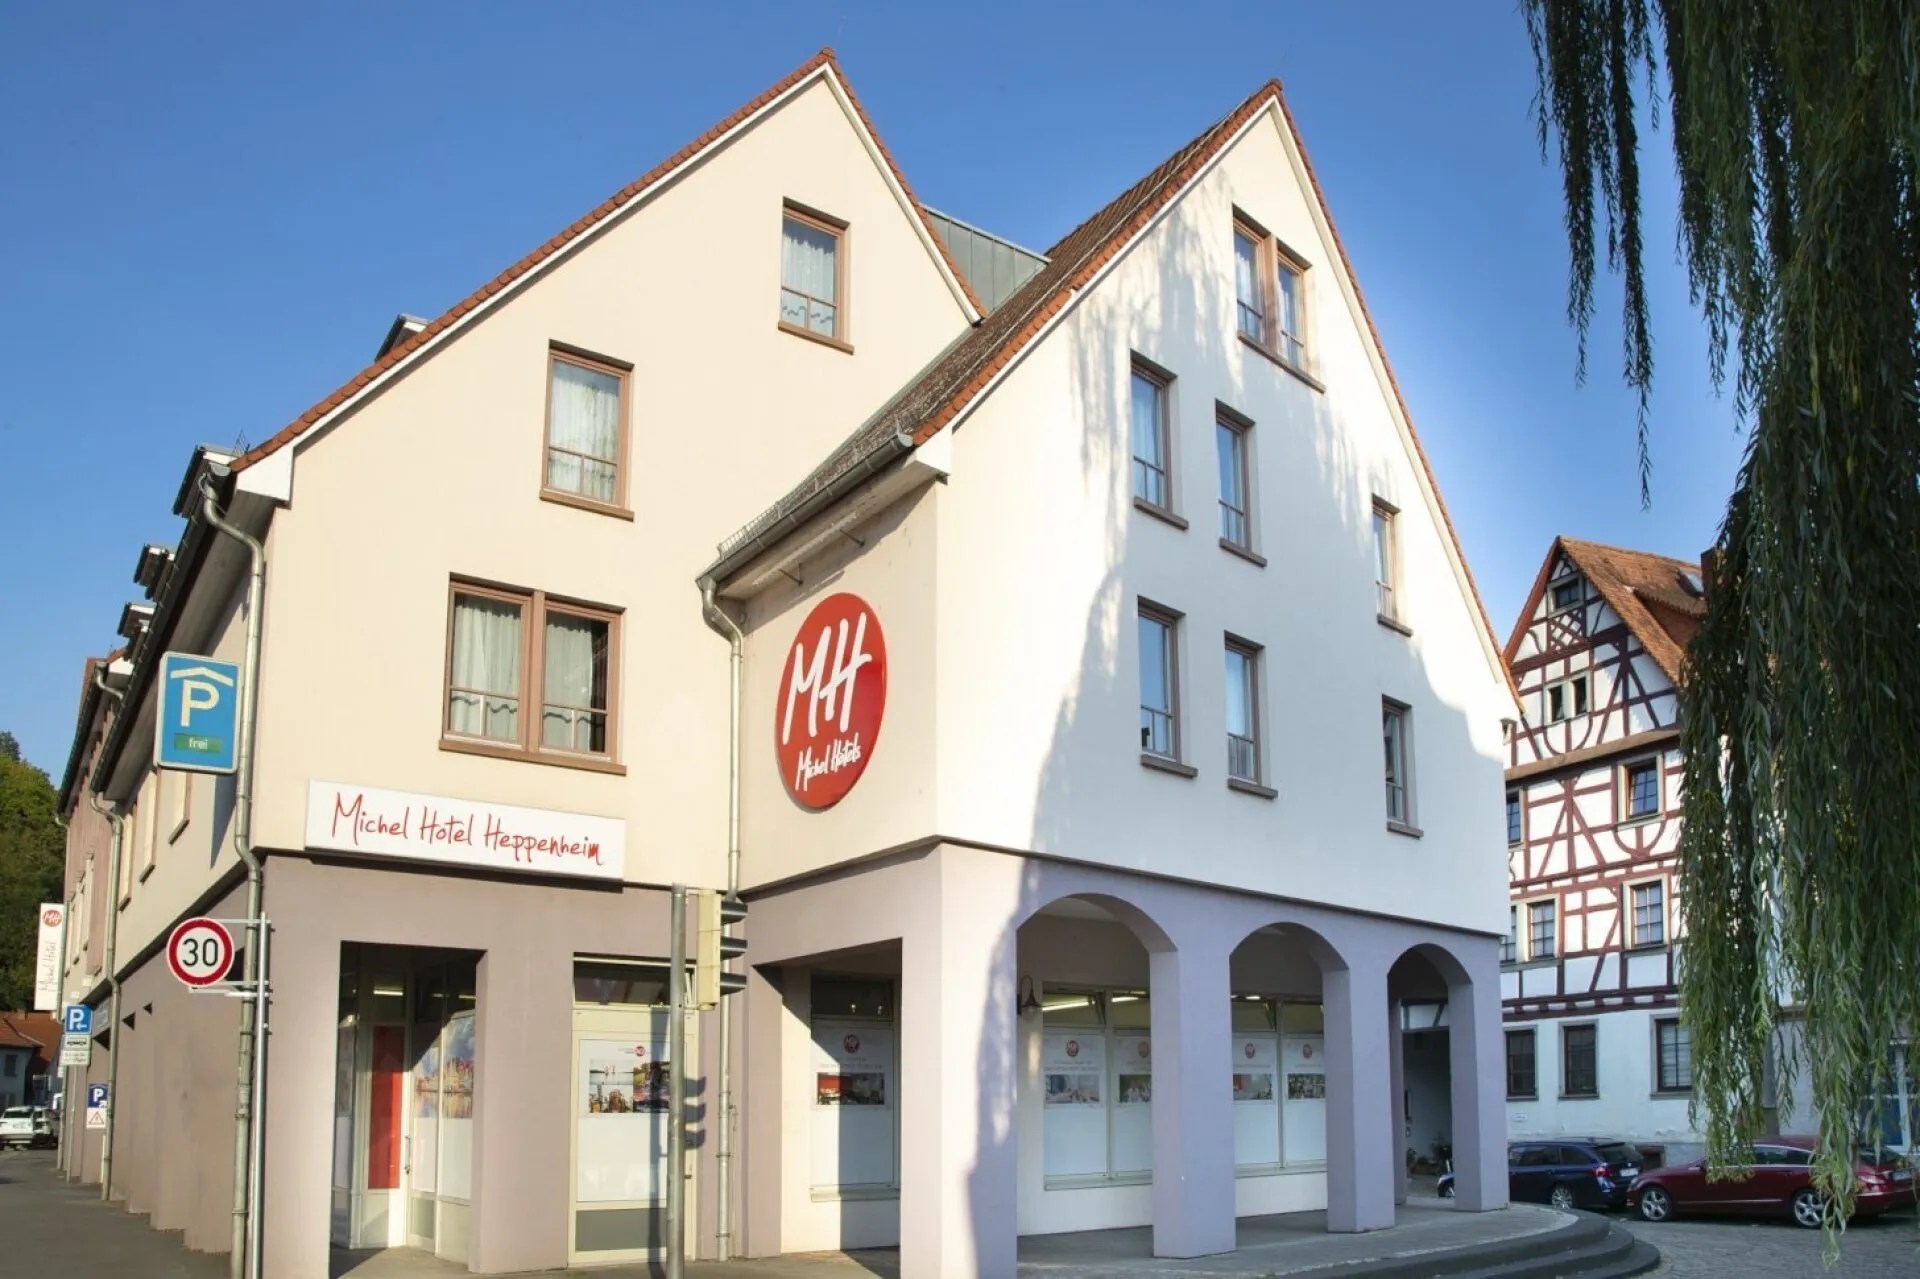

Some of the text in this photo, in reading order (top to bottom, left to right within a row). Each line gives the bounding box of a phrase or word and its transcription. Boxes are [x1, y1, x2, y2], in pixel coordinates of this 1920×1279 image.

[782, 612, 873, 745] MH
[181, 679, 219, 728] P
[188, 737, 208, 750] frei
[795, 732, 861, 792] Michel Hotels
[332, 791, 604, 866] Michel Hotel Heppenheim
[182, 937, 218, 967] 30
[69, 1009, 84, 1031] P
[93, 1088, 104, 1103] P
